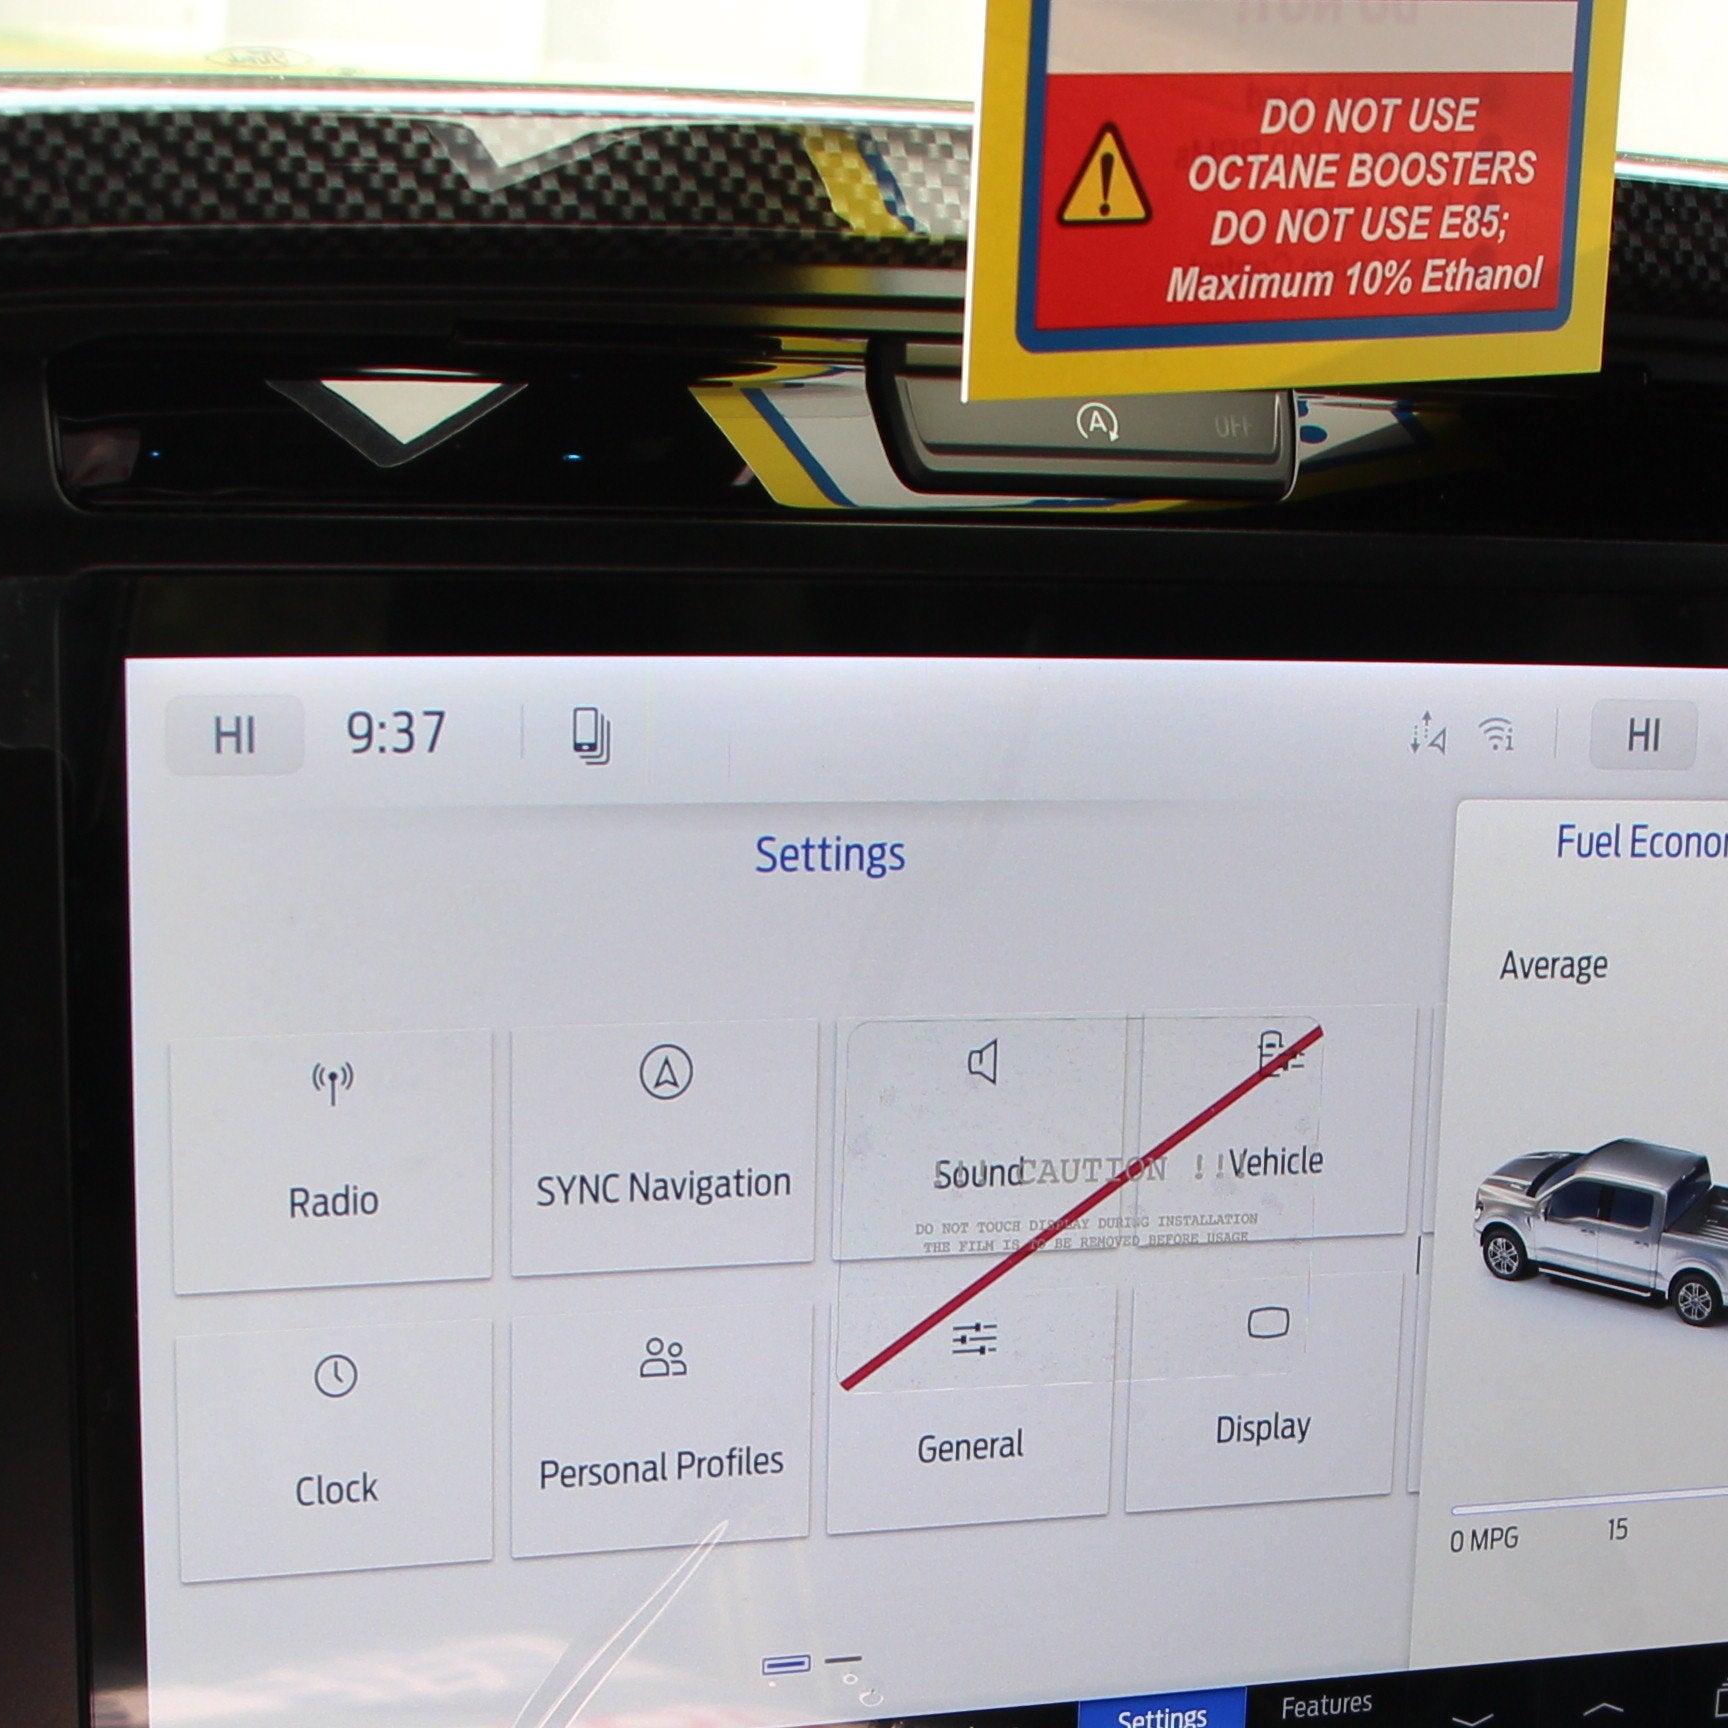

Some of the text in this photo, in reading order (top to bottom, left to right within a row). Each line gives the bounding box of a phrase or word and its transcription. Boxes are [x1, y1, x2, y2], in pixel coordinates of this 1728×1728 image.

[1261, 97, 1478, 134] DO NOT USE
[1188, 154, 1336, 191] OCTANE
[1347, 150, 1537, 189] BOOSTERS
[1211, 204, 1510, 246] DO NOT USE E85;
[1166, 256, 1543, 303] Maximum 10% Ethanol
[214, 716, 255, 754] HI
[347, 710, 446, 754] 9:37
[1627, 717, 1661, 752] HI
[755, 836, 906, 878] Settings
[1557, 823, 1620, 858] Fuel
[1500, 949, 1608, 985] Average
[934, 1155, 1025, 1190] Sound
[1229, 1144, 1324, 1177] Vehicle
[289, 1185, 379, 1218] Radio
[536, 1168, 791, 1207] SYNC Navigation
[915, 1212, 1259, 1236] DO NOT TOUCH DISPLAY DURING INSTALLATION
[923, 1242, 951, 1254] THE
[958, 1240, 995, 1253] FILM
[1002, 1238, 1020, 1251] IS
[1054, 1236, 1073, 1249] BE
[1080, 1233, 1140, 1249] REMOVED
[1148, 1231, 1200, 1247] BEFORE
[1207, 1229, 1249, 1244] USAGE
[1216, 1408, 1312, 1446] Display
[918, 1428, 1024, 1464] General
[539, 1446, 784, 1490] Personal Profiles
[296, 1472, 378, 1506] Clock
[1471, 1526, 1519, 1550] MPG
[1608, 1518, 1629, 1541] 15
[1281, 1691, 1373, 1720] Features
